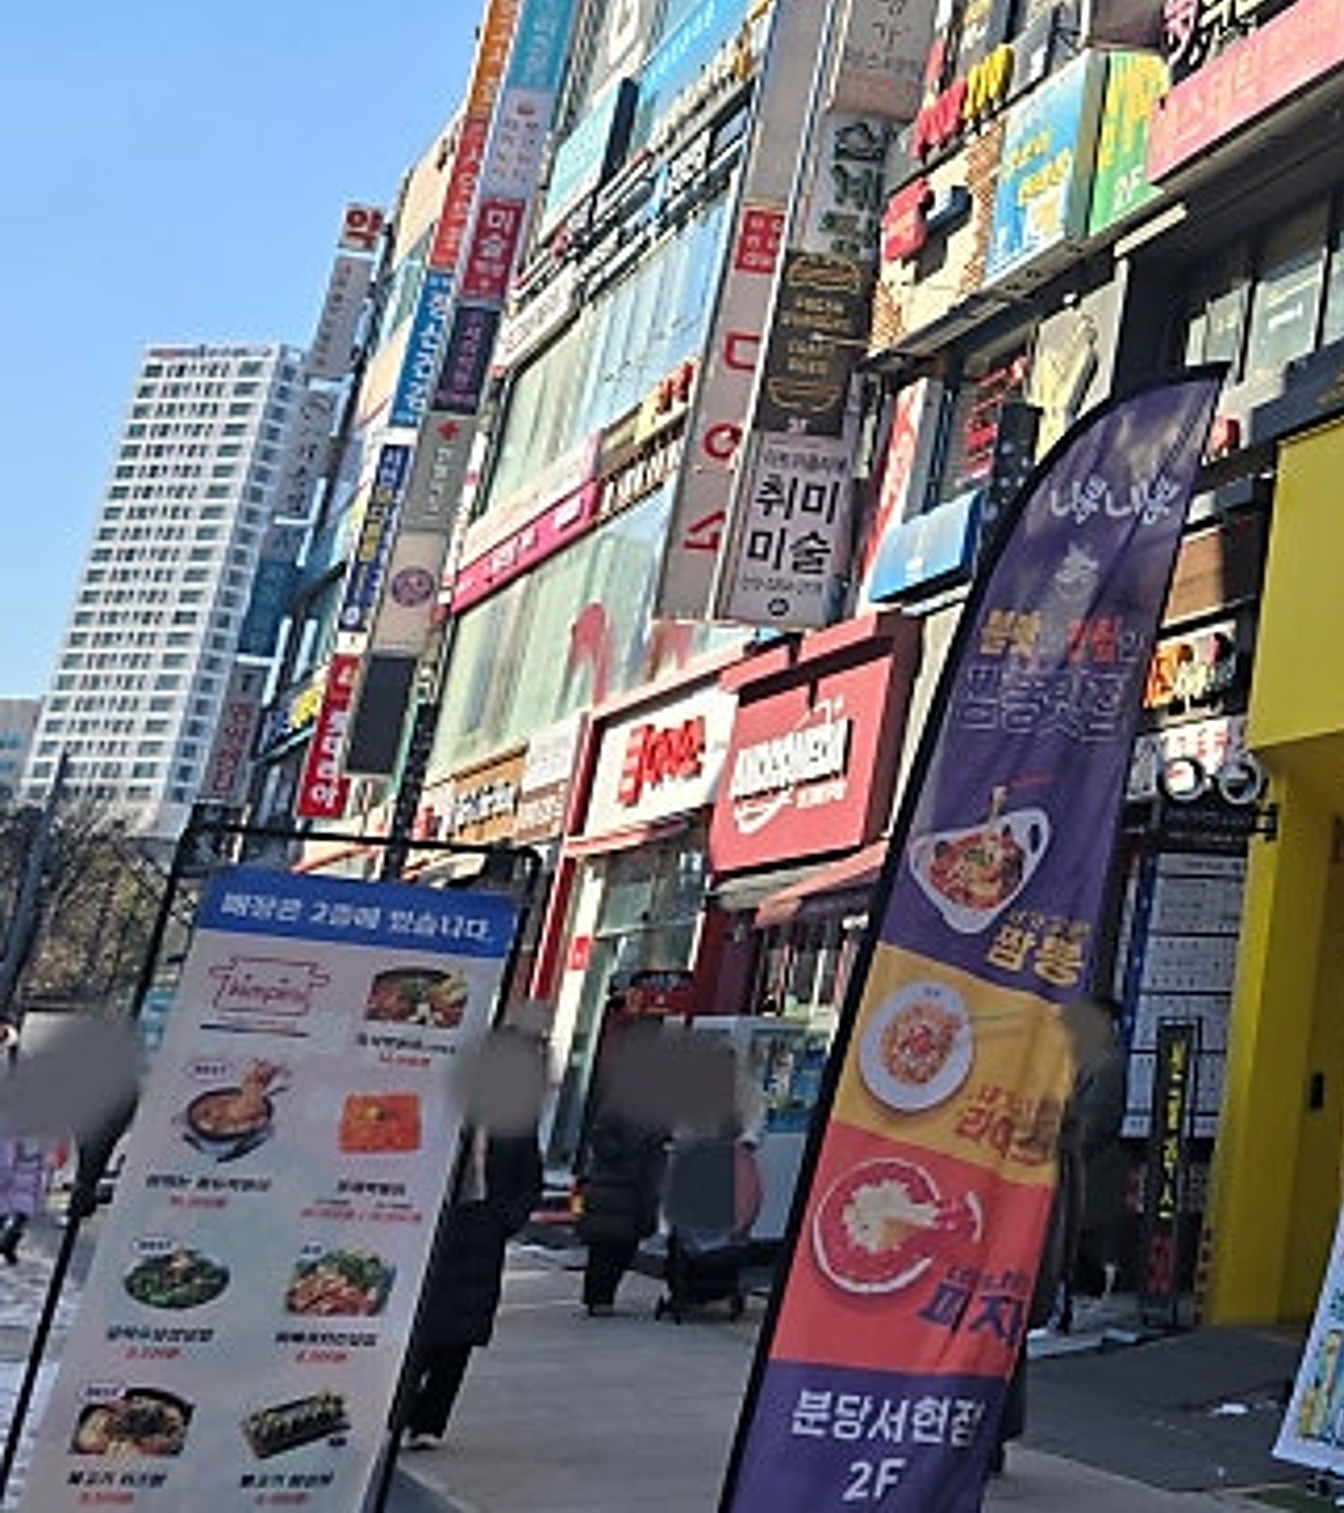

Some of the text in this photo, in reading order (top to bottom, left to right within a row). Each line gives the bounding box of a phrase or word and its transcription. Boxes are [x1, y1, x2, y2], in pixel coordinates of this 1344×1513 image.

[754, 473, 841, 525] 취미
[746, 527, 832, 576] 미술
[220, 891, 495, 942] 매장은 2층에 있습니다.
[917, 1279, 1026, 1352] 피자
[791, 1389, 986, 1449] 분당서현점
[841, 1456, 906, 1502] 2F
